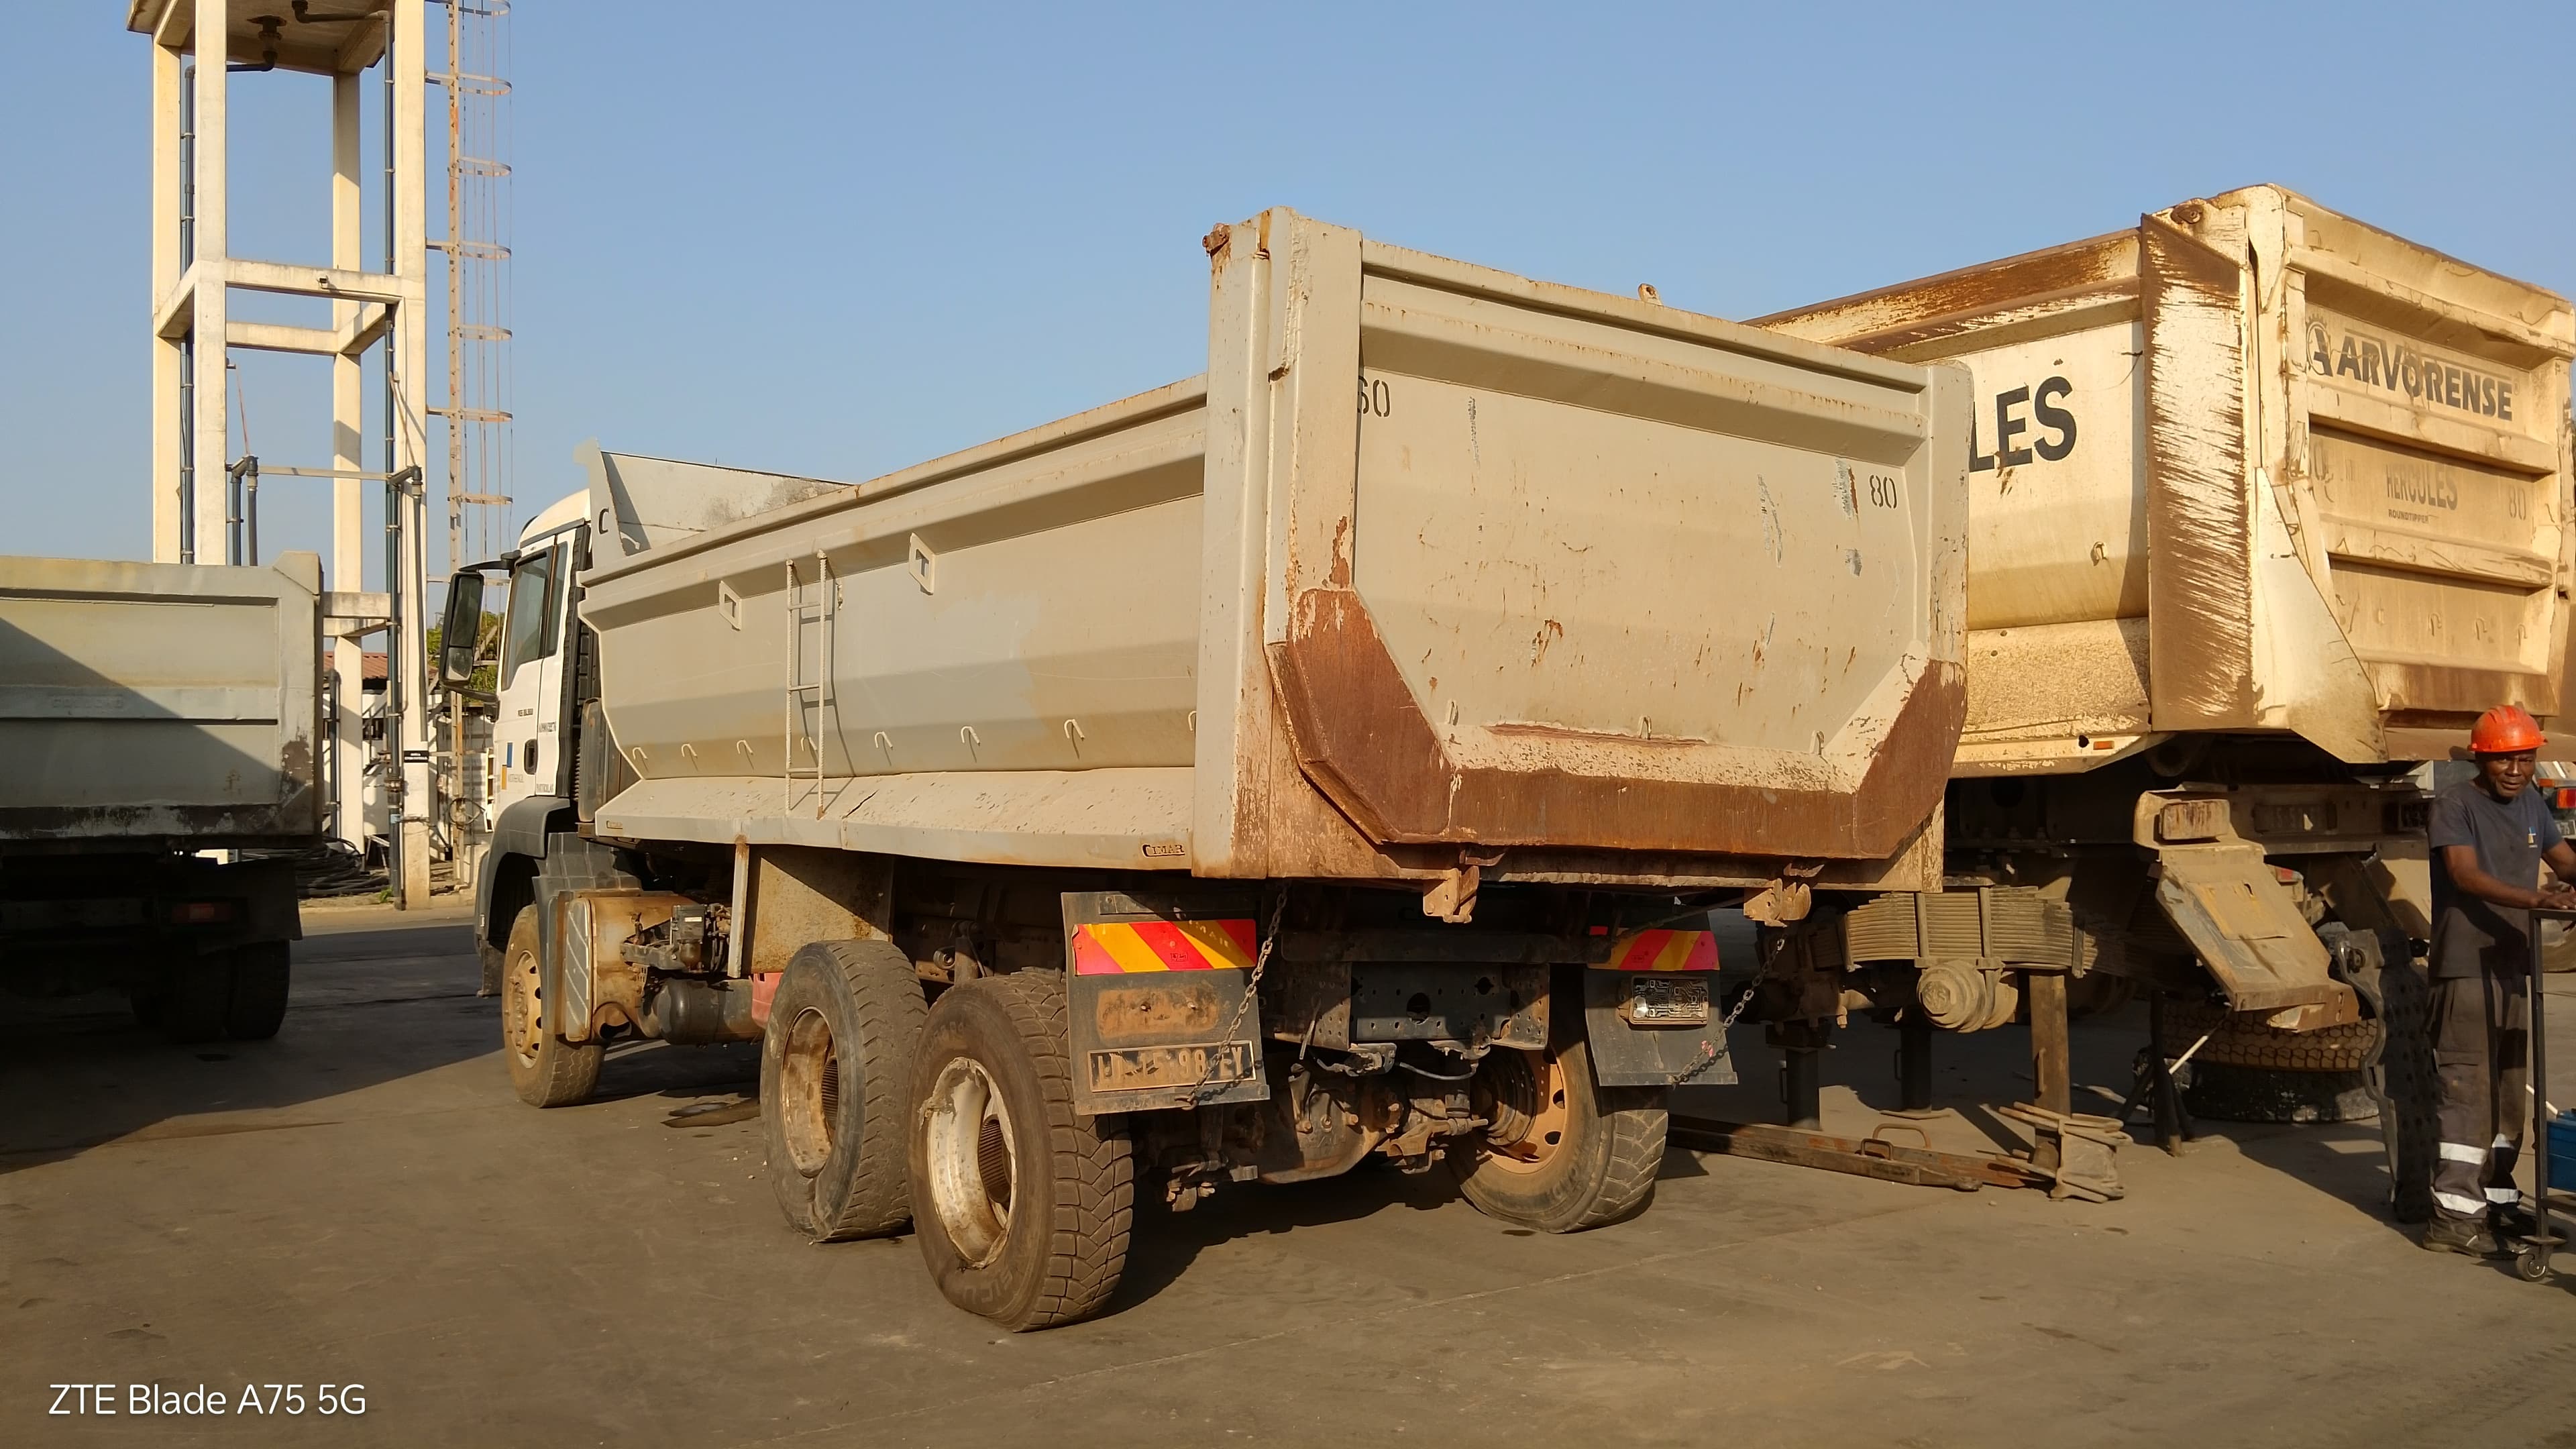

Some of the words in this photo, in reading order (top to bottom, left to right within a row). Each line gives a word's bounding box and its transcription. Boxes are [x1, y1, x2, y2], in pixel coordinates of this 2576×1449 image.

[2337, 335, 2513, 421] ARVORENSE
[1870, 474, 1897, 509] 80
[2385, 463, 2458, 511] HERCULES
[2509, 484, 2526, 521] 80
